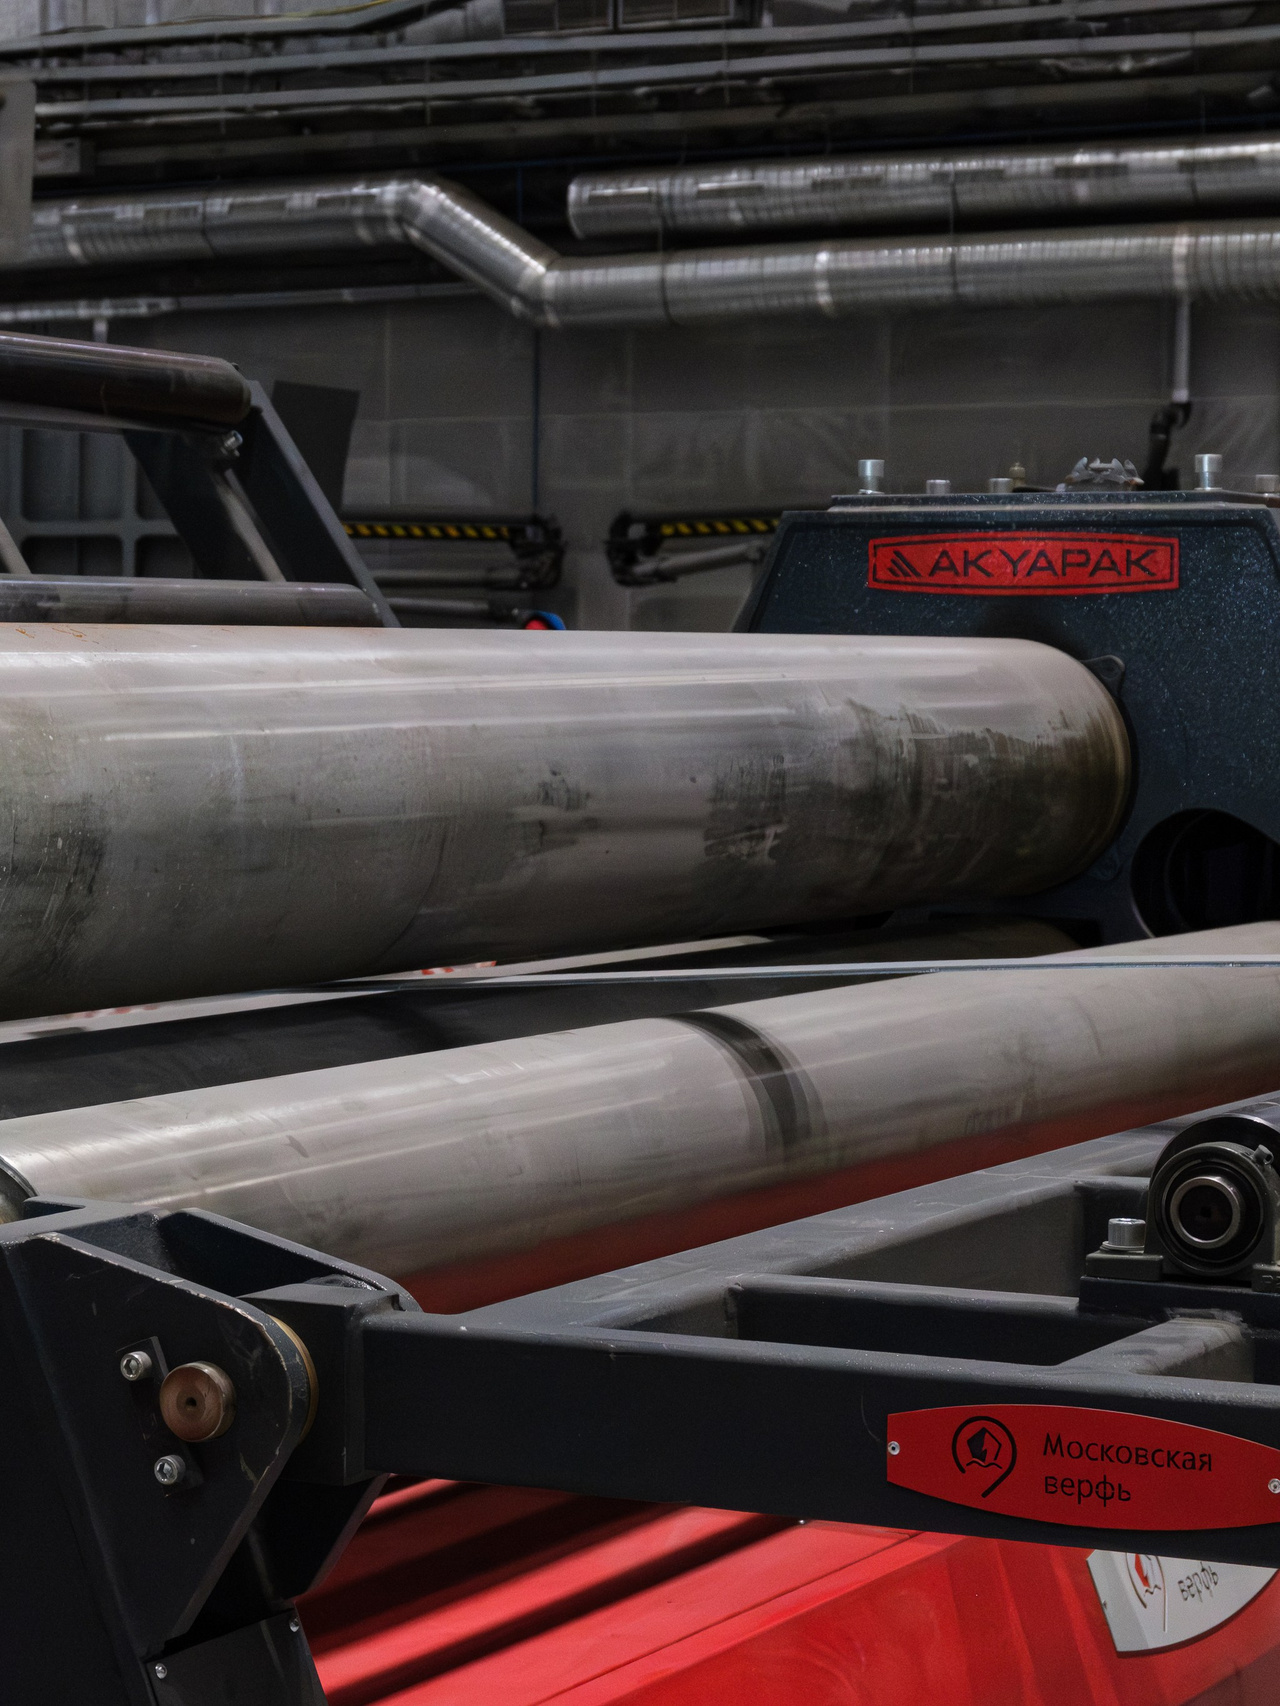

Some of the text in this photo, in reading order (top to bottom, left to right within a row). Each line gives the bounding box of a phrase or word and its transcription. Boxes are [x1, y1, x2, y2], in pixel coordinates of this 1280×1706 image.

[928, 548, 1158, 578] AKYAPAK
[1043, 1432, 1212, 1472] Московская
[1044, 1474, 1132, 1507] верфь
